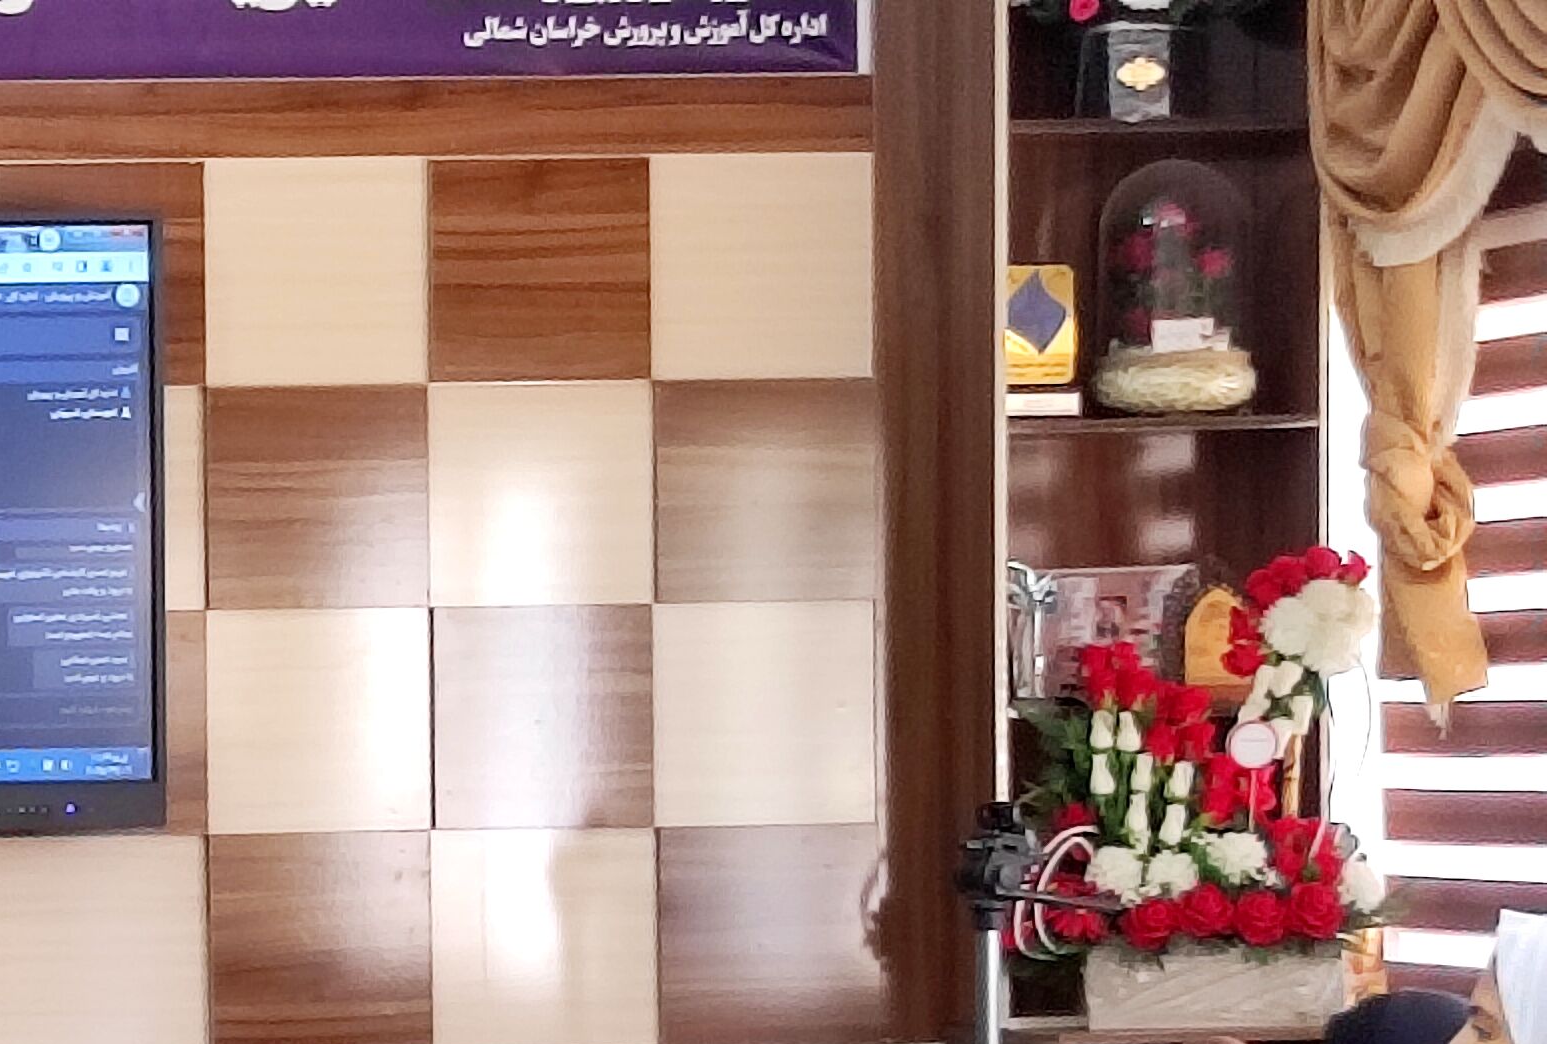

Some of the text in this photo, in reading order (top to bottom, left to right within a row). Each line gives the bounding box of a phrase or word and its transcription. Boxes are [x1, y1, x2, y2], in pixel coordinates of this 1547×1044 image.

[463, 9, 828, 48] اداره کل آموزش و پرورش خراسان شمالی
